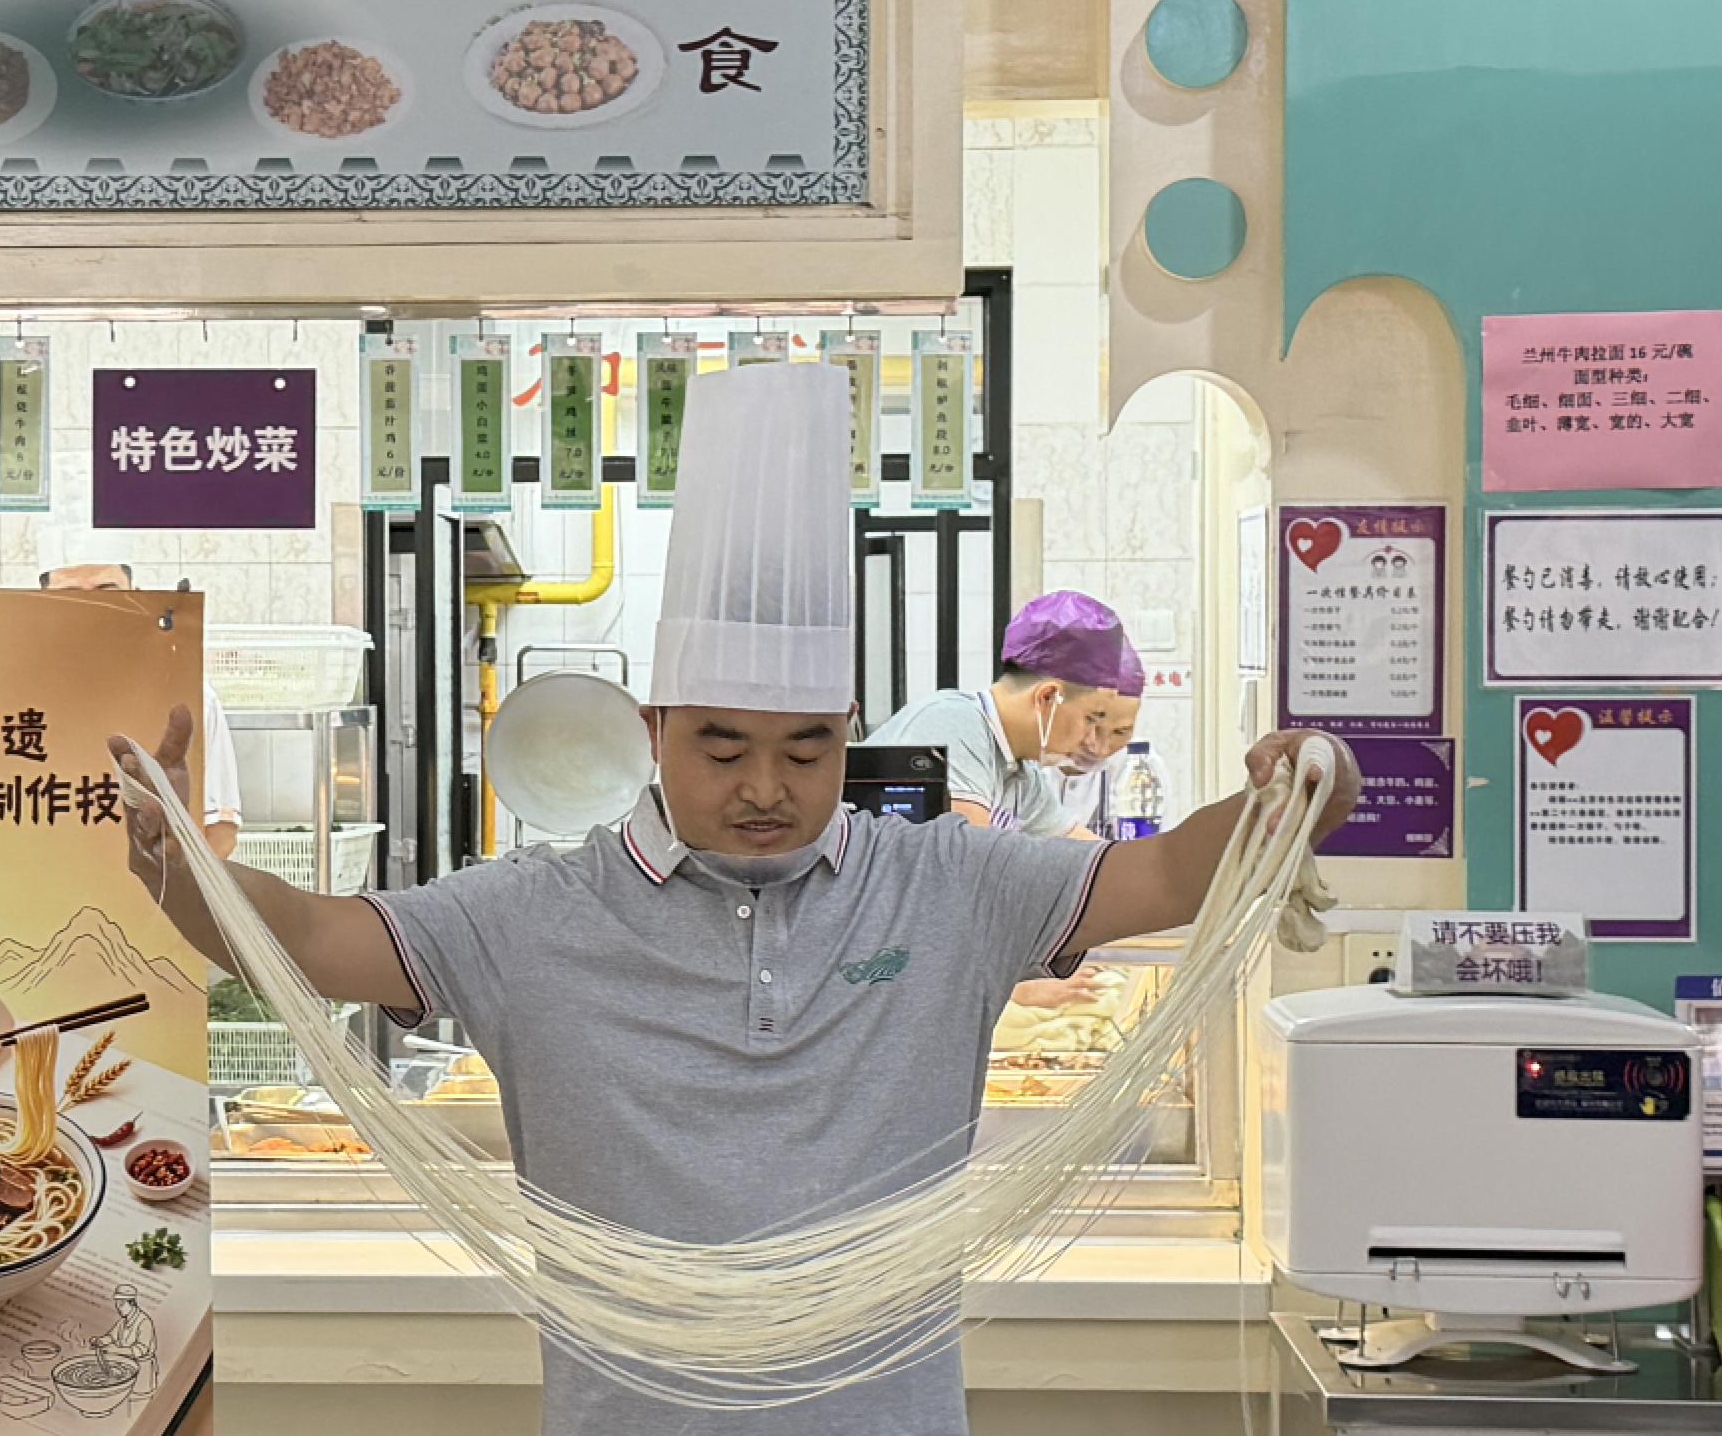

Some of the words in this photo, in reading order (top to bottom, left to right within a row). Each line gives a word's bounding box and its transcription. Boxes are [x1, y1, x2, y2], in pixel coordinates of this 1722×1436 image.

[678, 26, 779, 94] 食
[1522, 344, 1625, 364] 兰州牛肉拉面
[1630, 347, 1647, 359] 16
[110, 425, 299, 474] 特色炒菜
[1597, 707, 1674, 727] 温馨提示
[1432, 920, 1562, 947] 请不要压我
